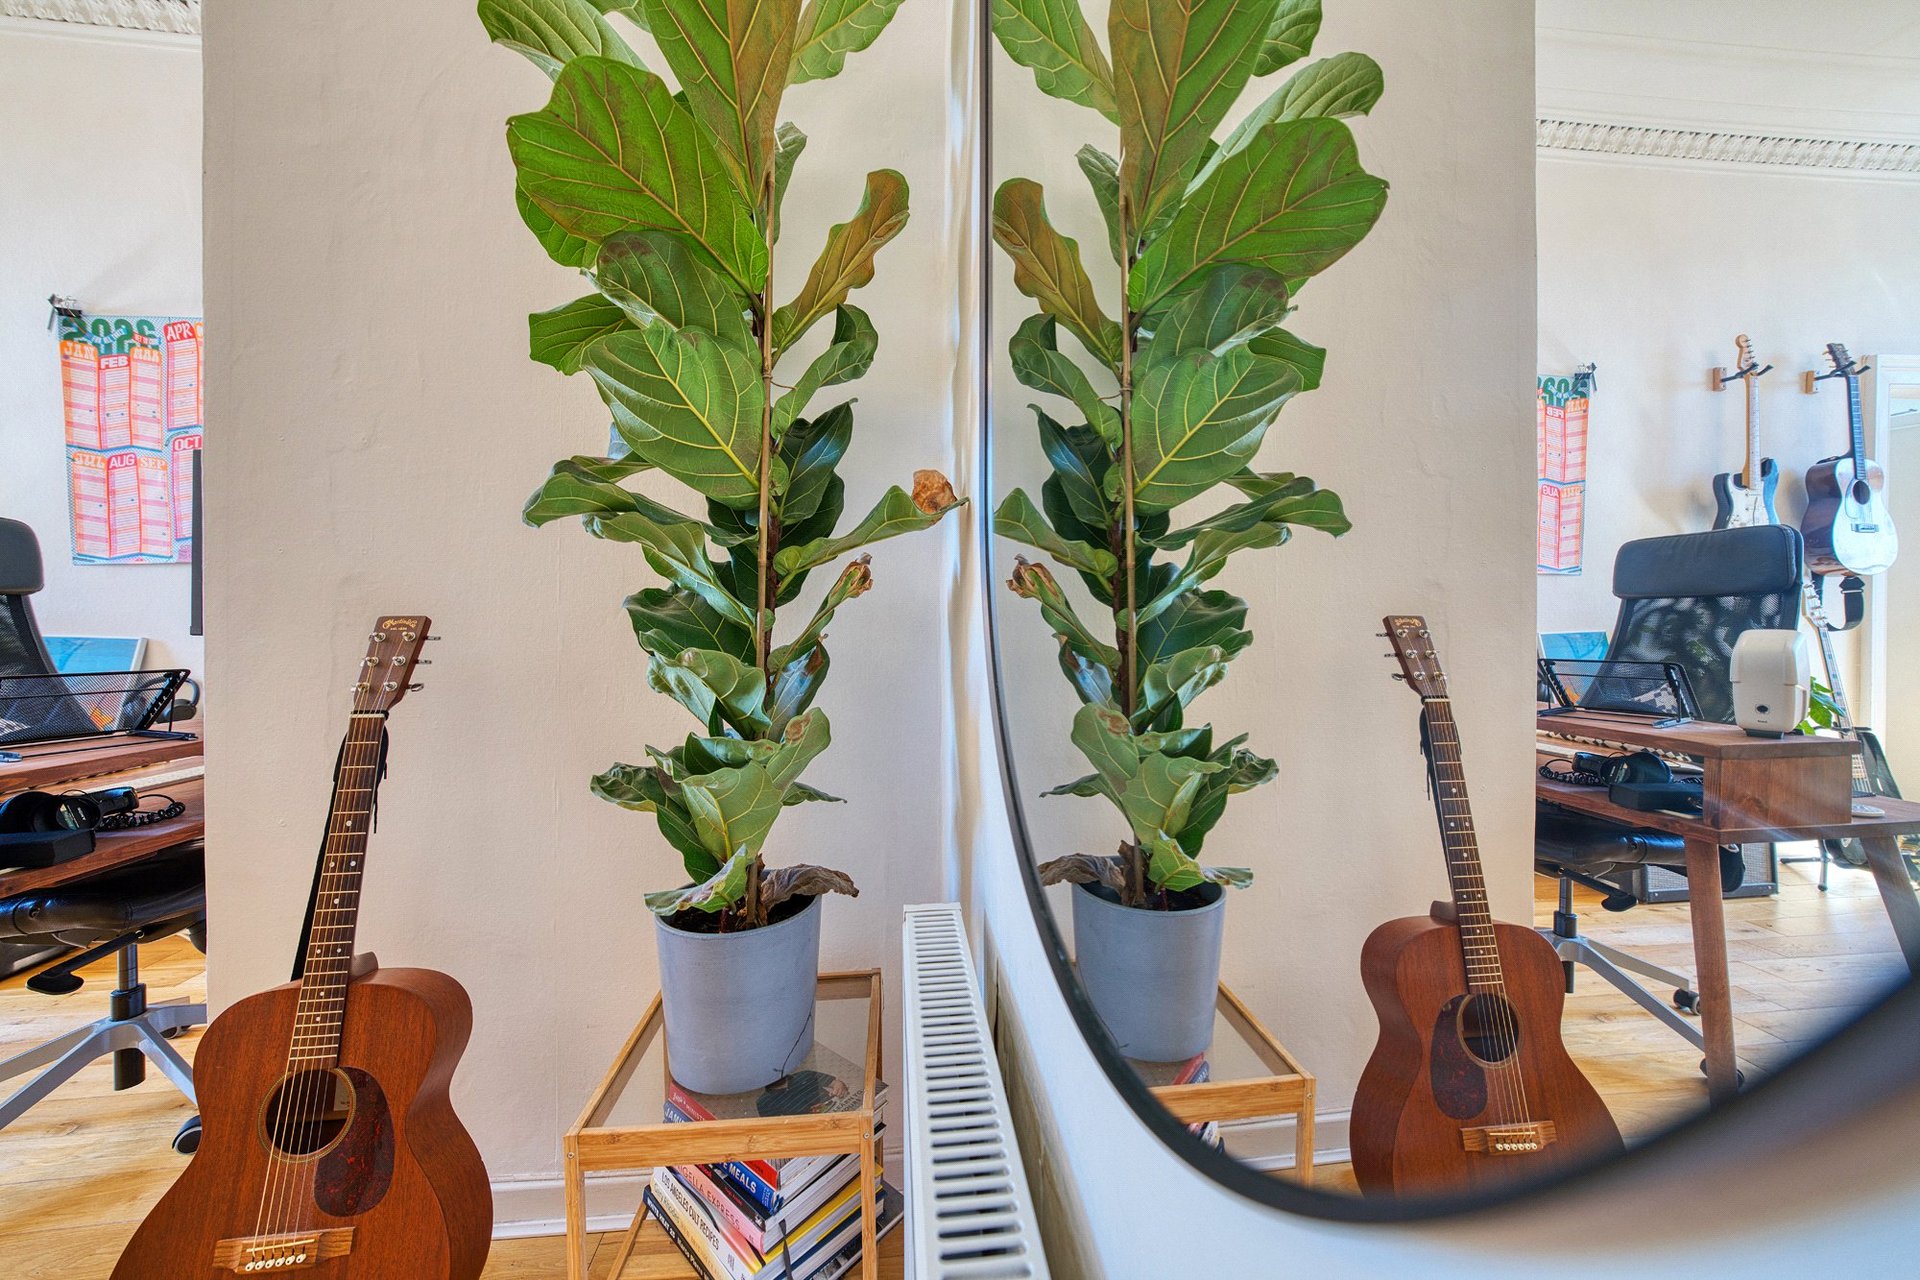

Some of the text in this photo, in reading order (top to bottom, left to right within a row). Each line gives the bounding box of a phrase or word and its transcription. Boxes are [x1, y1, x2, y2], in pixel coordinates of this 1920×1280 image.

[61, 318, 159, 355] 2026
[166, 323, 193, 341] APR
[64, 342, 95, 360] JAN
[133, 348, 159, 361] MAR
[100, 356, 129, 369] FEB
[174, 437, 201, 451] OCT
[74, 454, 105, 469] JUL
[108, 454, 136, 469] AUG
[140, 457, 166, 469] SEP
[729, 1163, 757, 1193] MEALS
[661, 1172, 720, 1250] LOS ANGELES CULT RECIPES
[706, 1190, 740, 1230] EXPRESS
